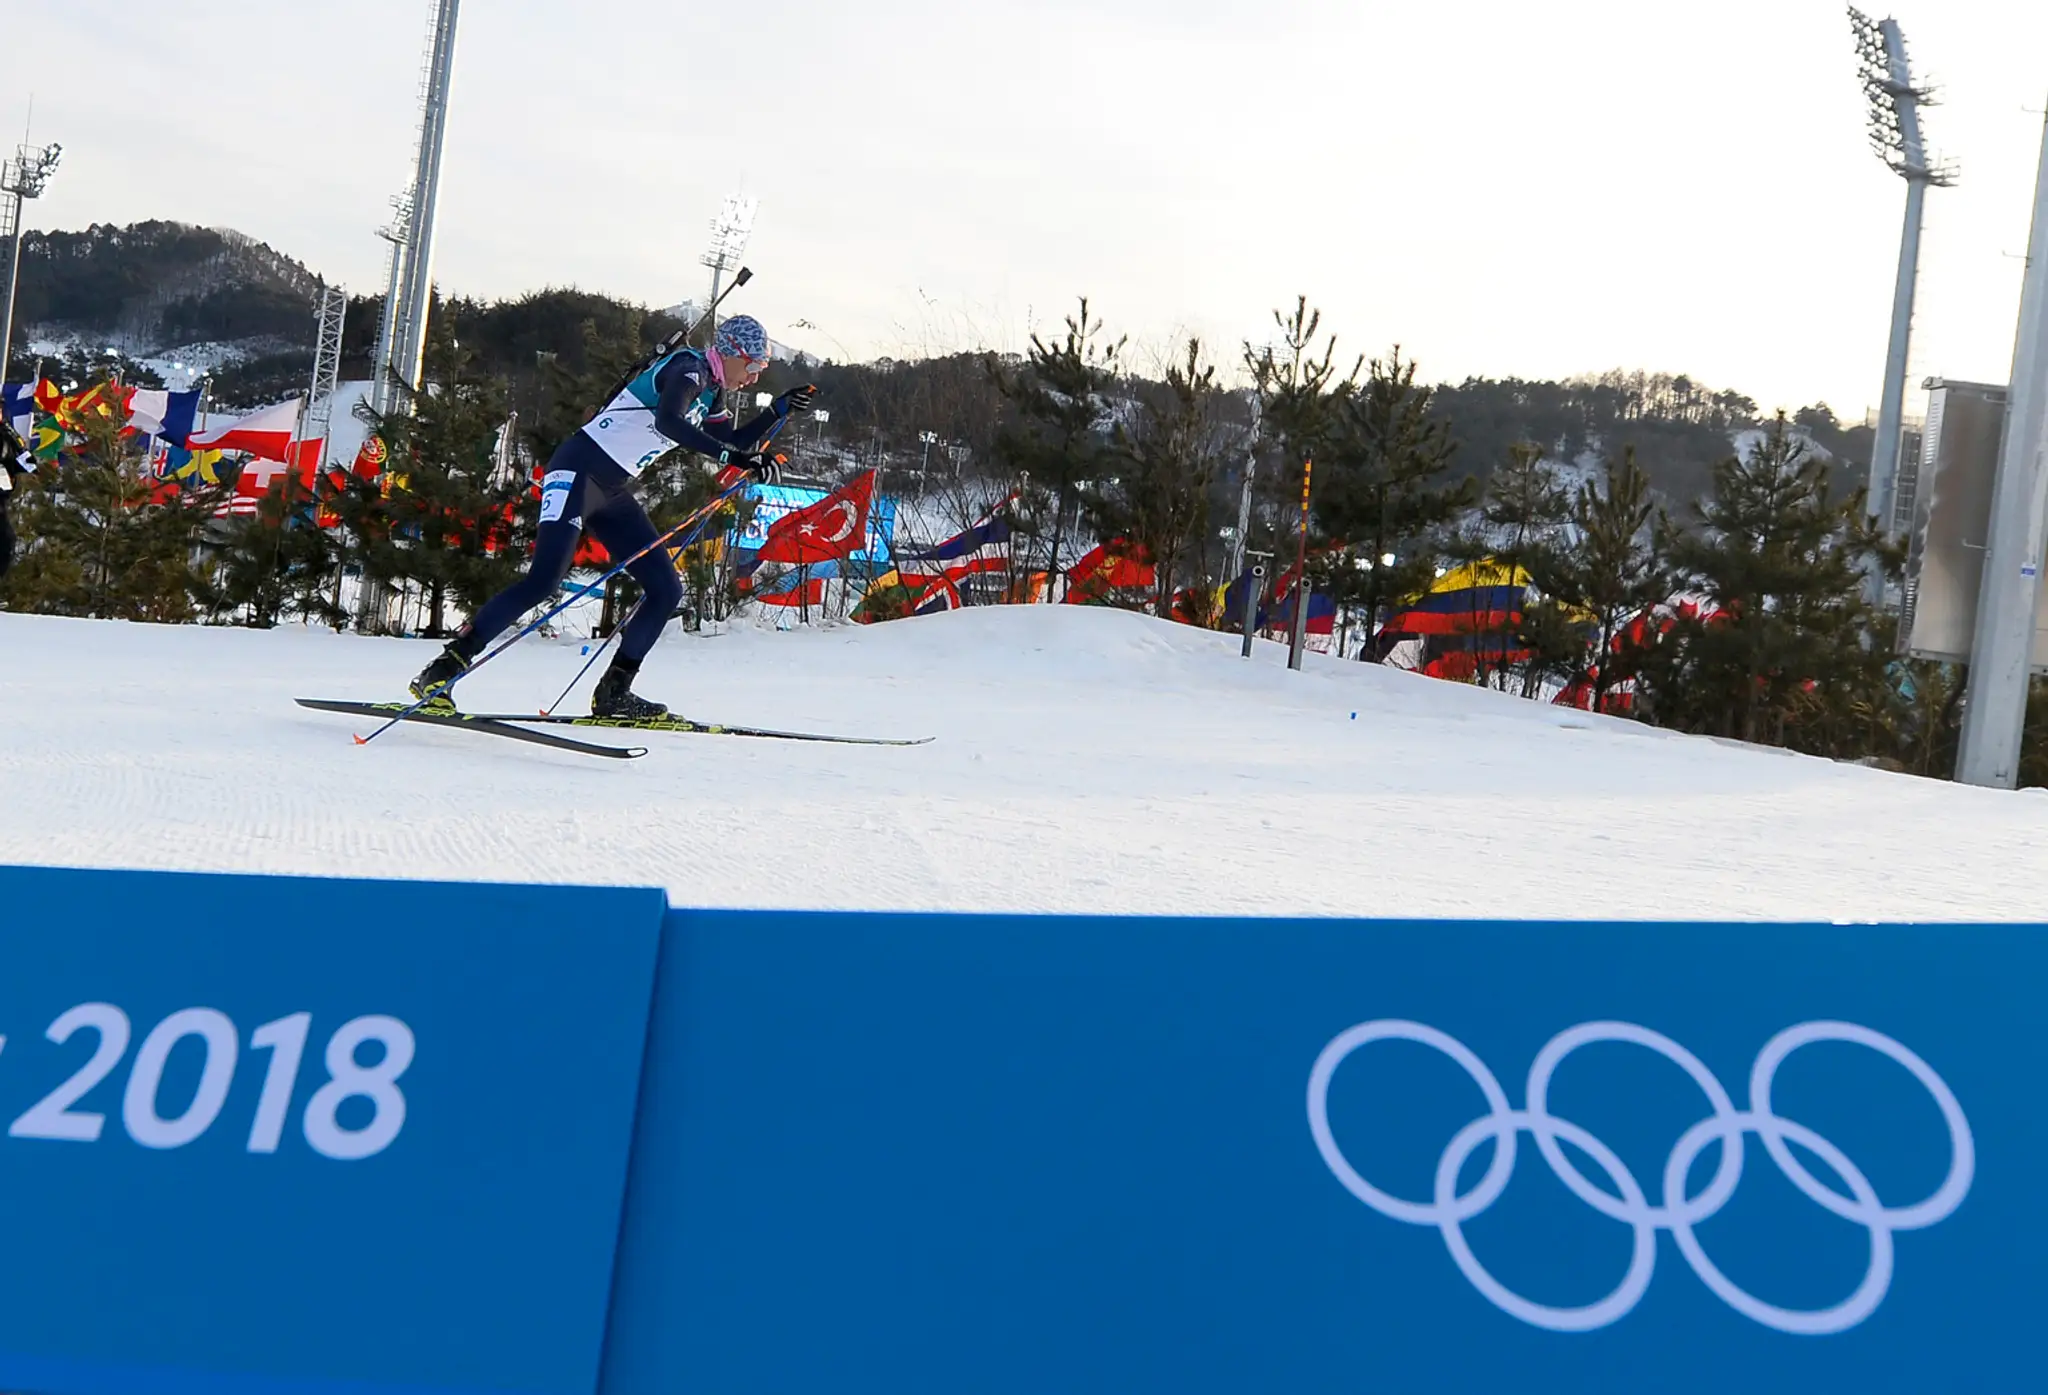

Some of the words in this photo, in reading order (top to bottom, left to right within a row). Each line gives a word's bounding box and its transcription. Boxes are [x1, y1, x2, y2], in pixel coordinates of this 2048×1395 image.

[598, 417, 614, 430] 6
[571, 718, 694, 732] FISCHER
[8, 1002, 416, 1160] 2018
